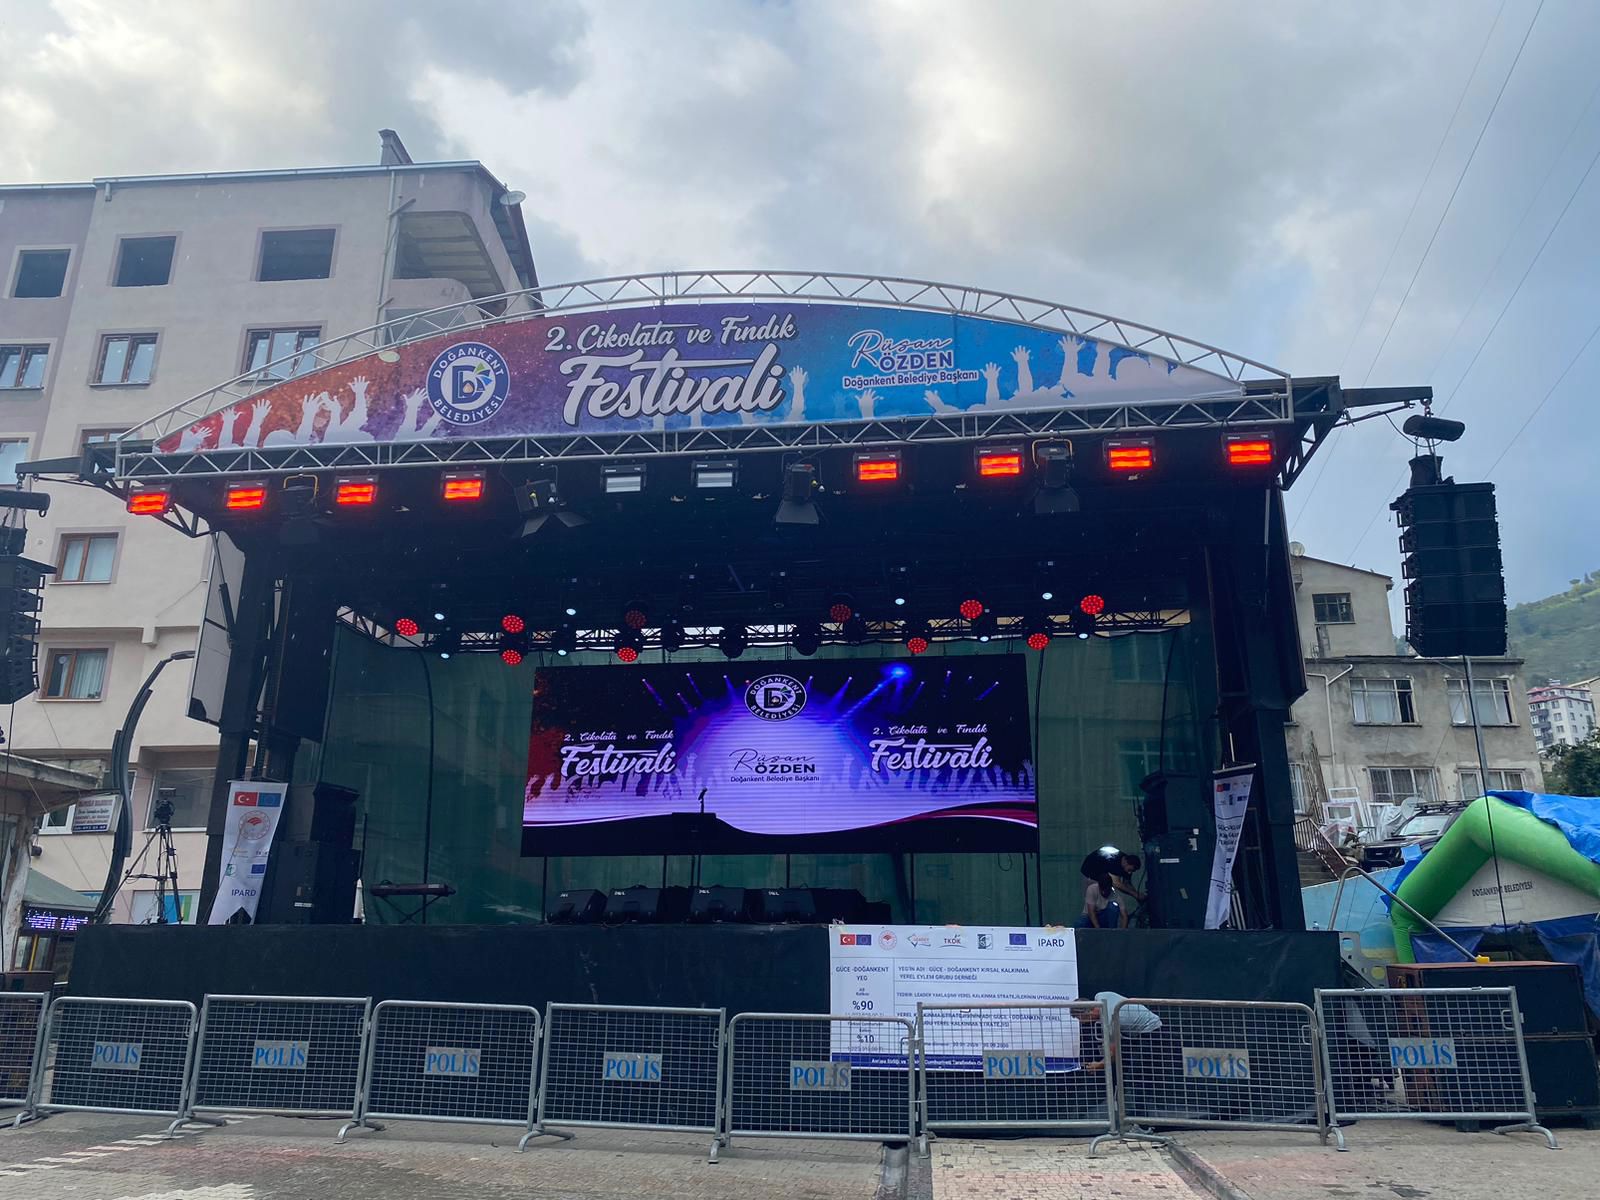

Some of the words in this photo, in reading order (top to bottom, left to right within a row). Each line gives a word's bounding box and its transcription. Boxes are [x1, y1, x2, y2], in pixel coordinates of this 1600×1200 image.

[544, 326, 572, 351] 2.
[577, 322, 698, 353] Çikolata
[686, 329, 711, 344] ve
[720, 314, 796, 344] Fındık
[433, 347, 504, 379] DOĞANKENT
[879, 351, 953, 372] ÖZDEN
[559, 343, 786, 426] Festivali
[843, 374, 896, 390] Doğankent
[898, 371, 938, 386] Belediye
[940, 369, 979, 384] Başkanı
[433, 394, 504, 422] BELEDİYESİ
[564, 734, 575, 742] 2.
[579, 731, 617, 742] Çikolata
[873, 727, 884, 735] 2.
[888, 725, 928, 736] Çikolata
[937, 726, 948, 734] ve
[560, 742, 676, 777] Festivali
[869, 736, 993, 772] Festivali
[730, 775, 764, 783] Doğankent
[766, 774, 793, 783] Belediye
[755, 762, 815, 774] ÖZDEN
[231, 889, 257, 897] IPARD
[1037, 938, 1065, 948] IPARD
[947, 966, 980, 974] DOĞANKENT
[852, 1000, 874, 1011] %90
[857, 1035, 875, 1043] %10
[94, 1043, 139, 1064] POLİS
[254, 1043, 306, 1066] POLİS
[427, 1050, 479, 1073] POLİS
[985, 1052, 1046, 1077] POLİS
[1391, 1040, 1456, 1067] POLİS
[606, 1054, 661, 1080] POLİS
[793, 1063, 849, 1088] POLİS
[1185, 1053, 1248, 1079] POLİS
